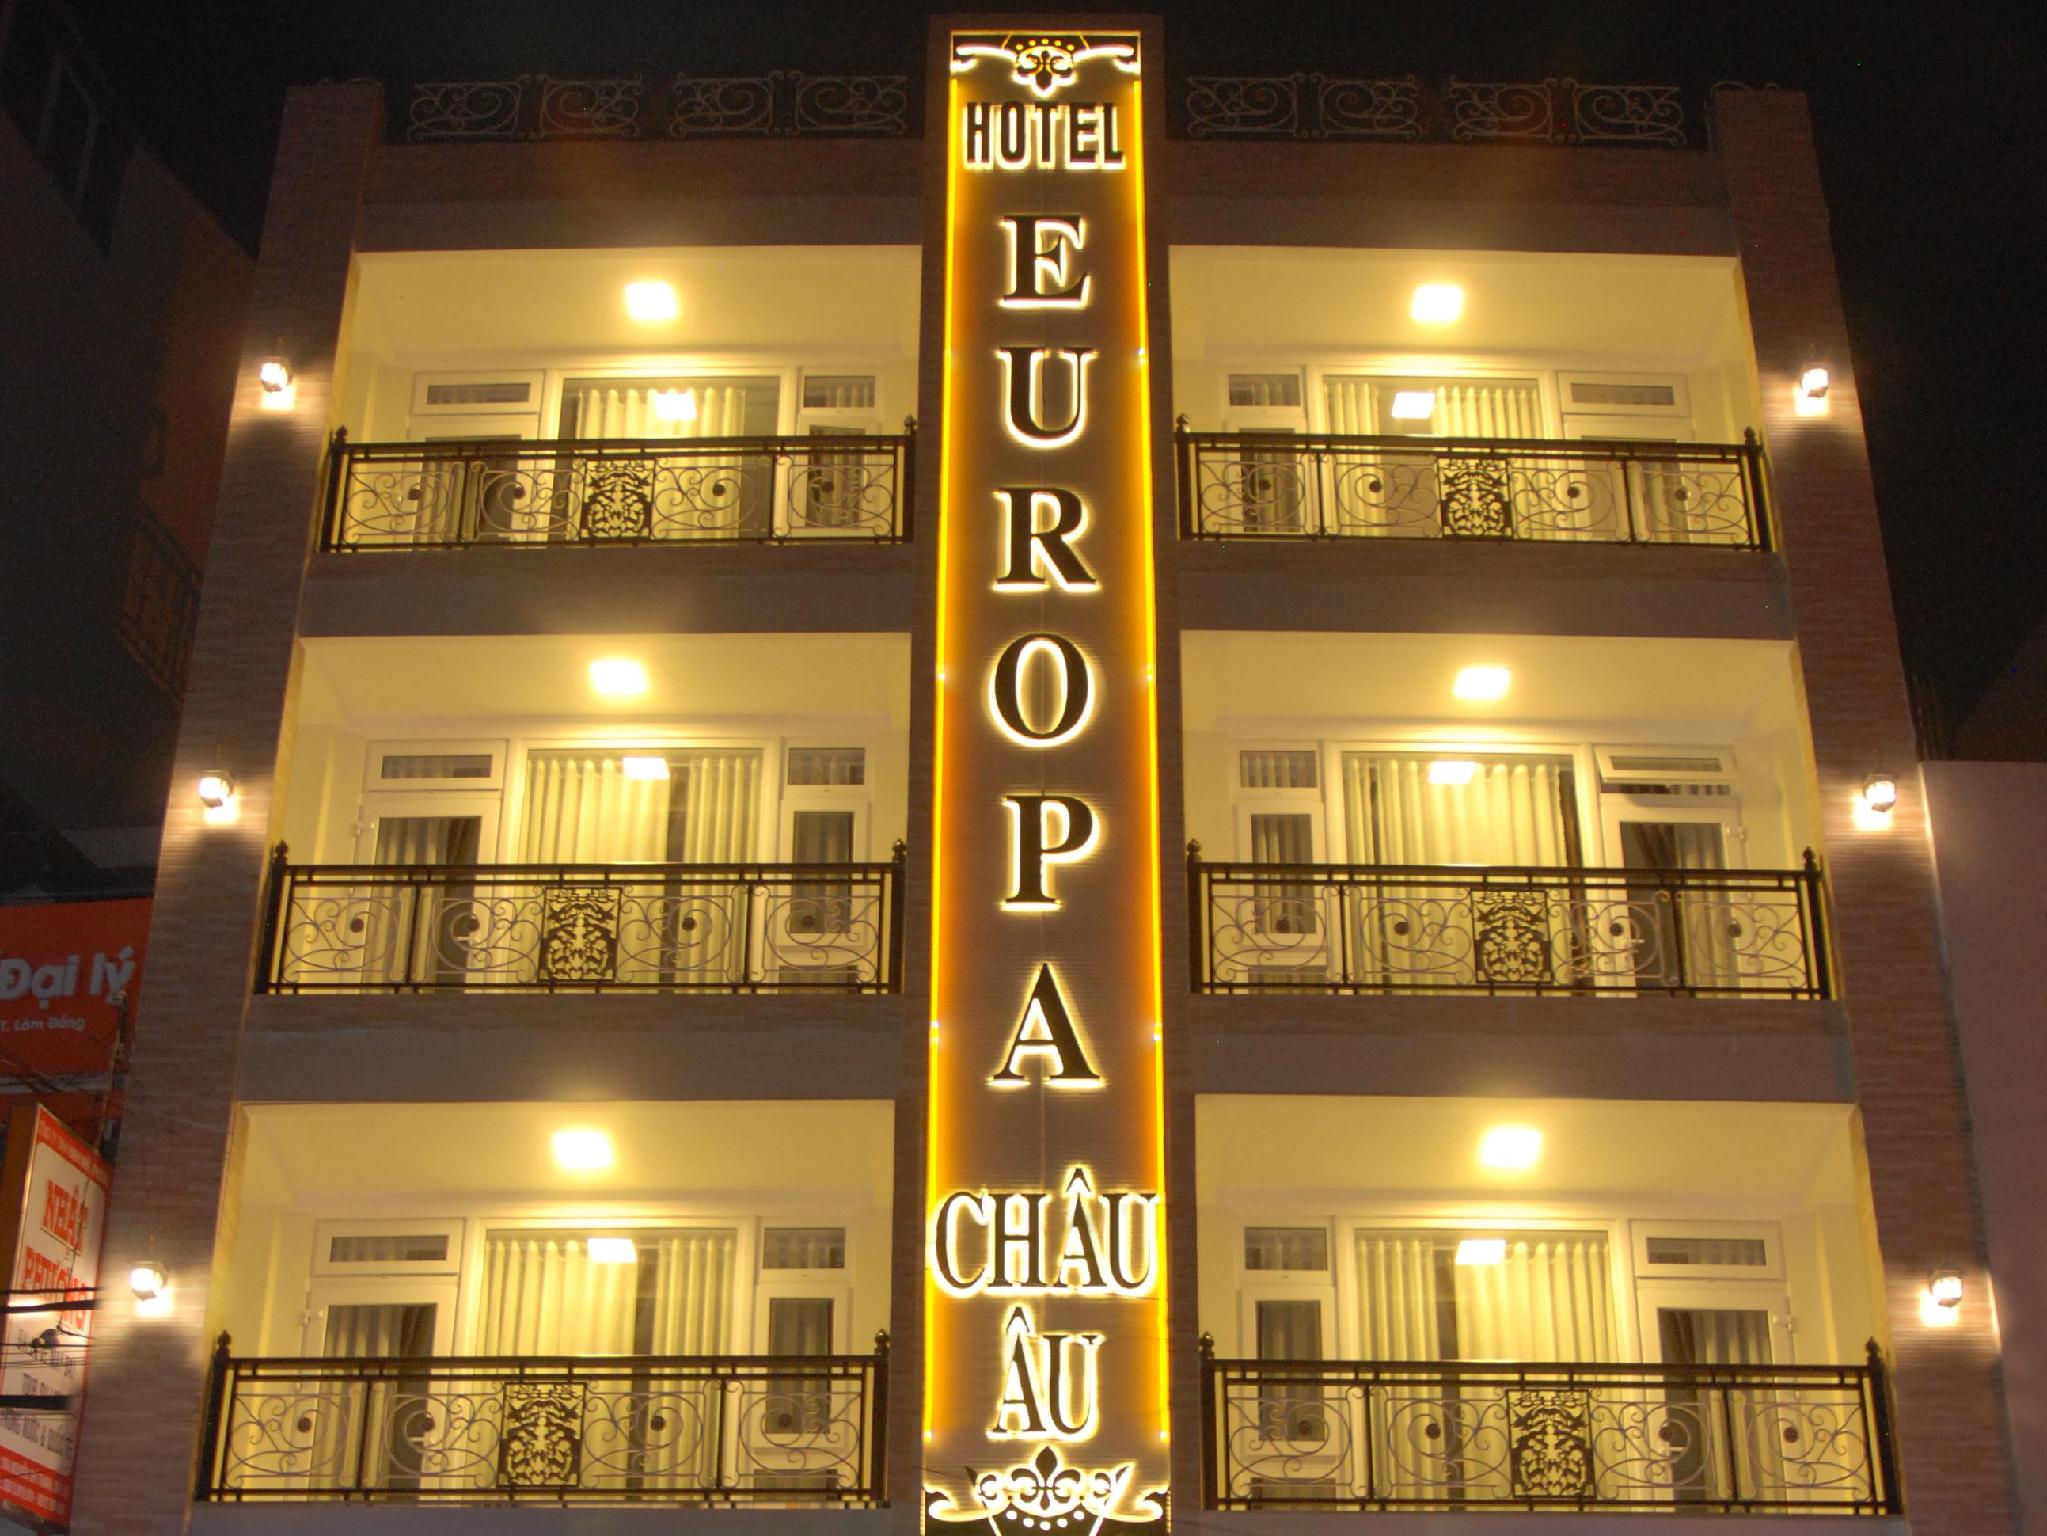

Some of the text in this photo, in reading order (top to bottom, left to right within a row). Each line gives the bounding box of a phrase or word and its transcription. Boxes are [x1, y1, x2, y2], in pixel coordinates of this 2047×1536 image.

[963, 101, 1126, 169] HOTEL
[988, 214, 1105, 1087] EUROPA
[89, 945, 136, 1006] lý
[932, 1165, 1160, 1296] CHÂU
[990, 1304, 1104, 1440] ÂU
